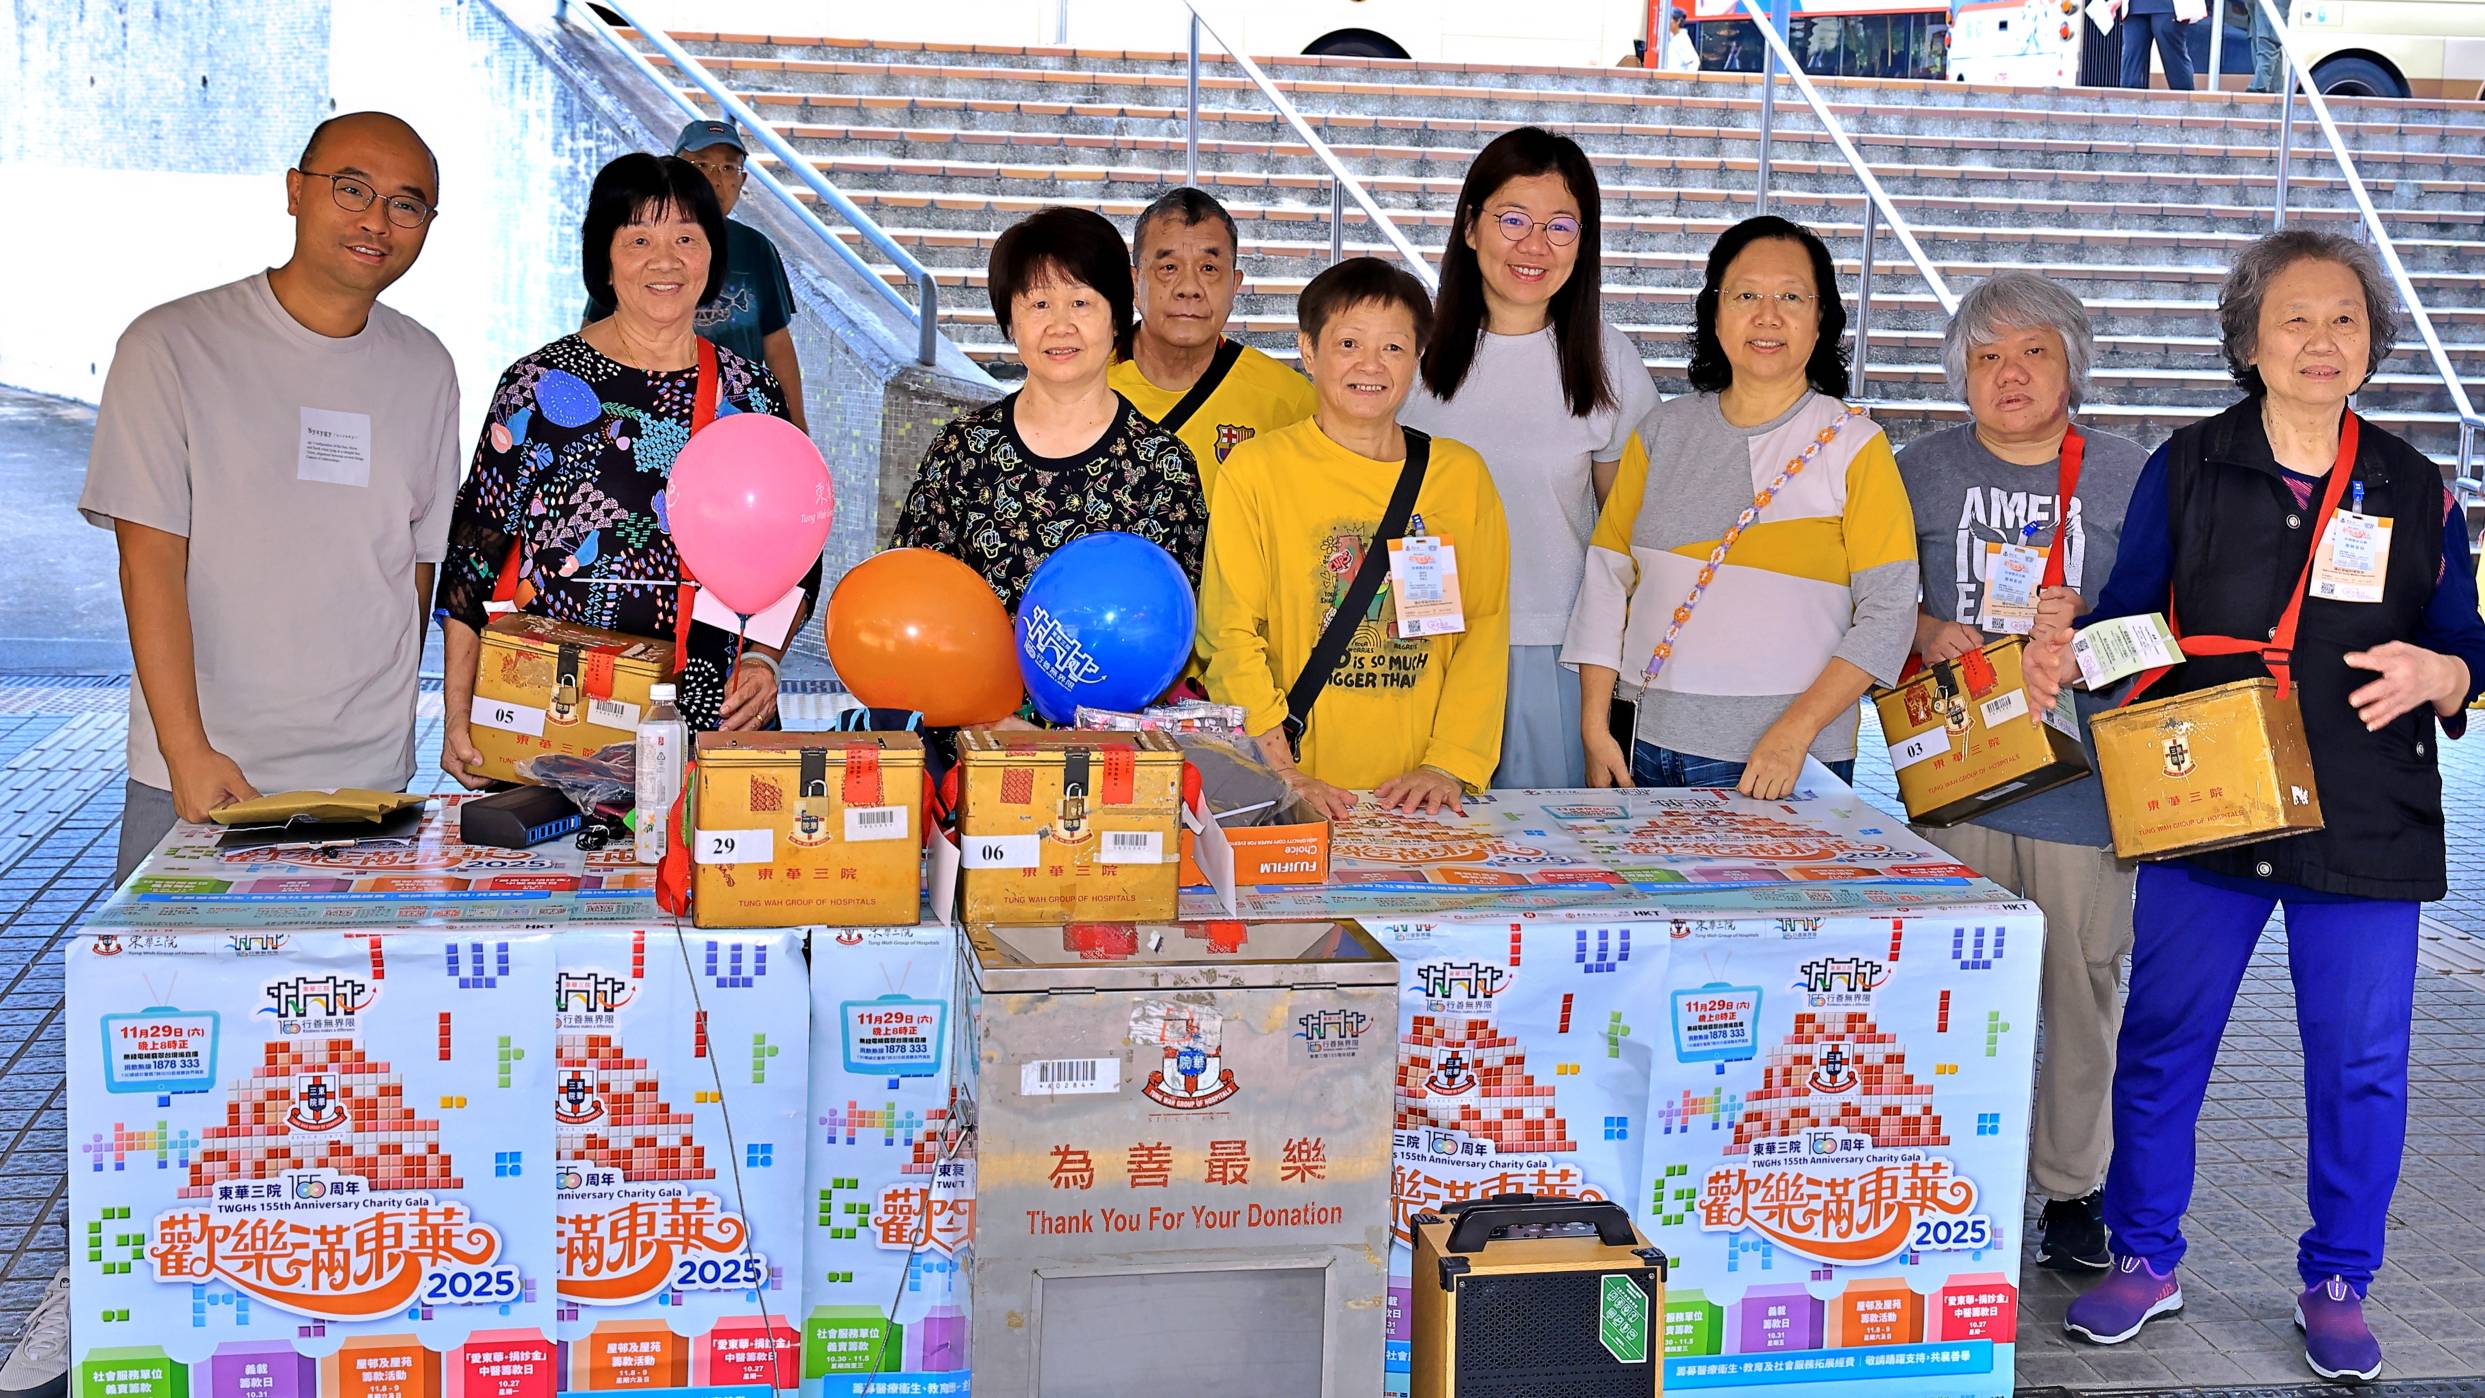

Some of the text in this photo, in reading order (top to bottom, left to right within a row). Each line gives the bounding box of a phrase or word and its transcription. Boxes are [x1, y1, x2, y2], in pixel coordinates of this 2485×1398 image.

[1328, 672, 1377, 688] IGGER
[495, 708, 514, 724] 05
[1907, 742, 1923, 758] 03
[713, 838, 736, 855] 29
[982, 844, 1004, 861] 06
[1285, 846, 1318, 855] Choice
[466, 860, 546, 868] 2025
[1260, 860, 1317, 874] FUJIFILM
[758, 868, 857, 881] 東華三院
[1022, 864, 1119, 878] 東華三院
[830, 898, 876, 906] HOSPITALS
[1004, 896, 1025, 904] TUNG
[1028, 896, 1046, 904] WAH
[1092, 894, 1136, 902] HOSPITALS
[1826, 993, 1870, 1003] 行善無界限
[1446, 1000, 1492, 1010] 行善無界限
[1685, 1000, 1750, 1012] 11月29日 (六)
[302, 1018, 356, 1028] 行善無界限
[564, 1014, 614, 1024] 行善無界限
[857, 1012, 933, 1026] 11月29日 (六)
[1698, 1012, 1736, 1022] 晚上8時正
[120, 1025, 204, 1039] 11月29日 (六)
[872, 1026, 918, 1036] 晚上8時正
[1709, 1029, 1745, 1040] 1878 333
[138, 1040, 188, 1051] 晚上8時正
[885, 1044, 928, 1053] 1878 333
[152, 1059, 200, 1070] 1878 333
[1150, 1086, 1233, 1108] TUNG WAH GROUP OF HOSPITALS
[1393, 1135, 1420, 1148] 三院
[1460, 1142, 1488, 1156] 周年
[1752, 1140, 1801, 1156] 東華三院
[1840, 1138, 1865, 1152] 周年
[1049, 1136, 1327, 1190] 為善最樂
[1400, 1152, 1548, 1170] 155th Anniversary Charity Gala
[1752, 1154, 1921, 1168] TWGHs 155th Anniversary Charity Gala
[586, 1172, 616, 1186] 周年
[218, 1184, 282, 1200] 東華三院
[330, 1181, 360, 1195] 周年
[556, 1188, 682, 1200] nniversary Charity Gala
[217, 1197, 430, 1214] TWGHs 155th Anniversary Charity Gala
[1699, 1162, 1974, 1244] 歡樂滿東華
[1027, 1200, 1342, 1237] Thank You For Your Donation
[1916, 1220, 1986, 1246] 2025
[150, 1207, 496, 1298] 歡樂滿東華
[678, 1259, 762, 1284] 2025
[427, 1270, 515, 1298] 2025
[1665, 1312, 1703, 1322] 服務單位
[1860, 1312, 1897, 1324] 籌款活動
[1954, 1306, 1998, 1318] 中醫籌款日
[1665, 1324, 1694, 1335] 賣籌款
[1763, 1318, 1790, 1329] 籌款日
[816, 1328, 880, 1339] 社會服務單位
[612, 1355, 656, 1367] 籌款活動
[93, 1368, 163, 1383] 社會服務單位
[362, 1370, 407, 1382] 籌款活動
[479, 1364, 534, 1377] 中醫籌款日
[240, 1377, 273, 1389] 籌款日
[498, 1380, 520, 1388] 10.27
